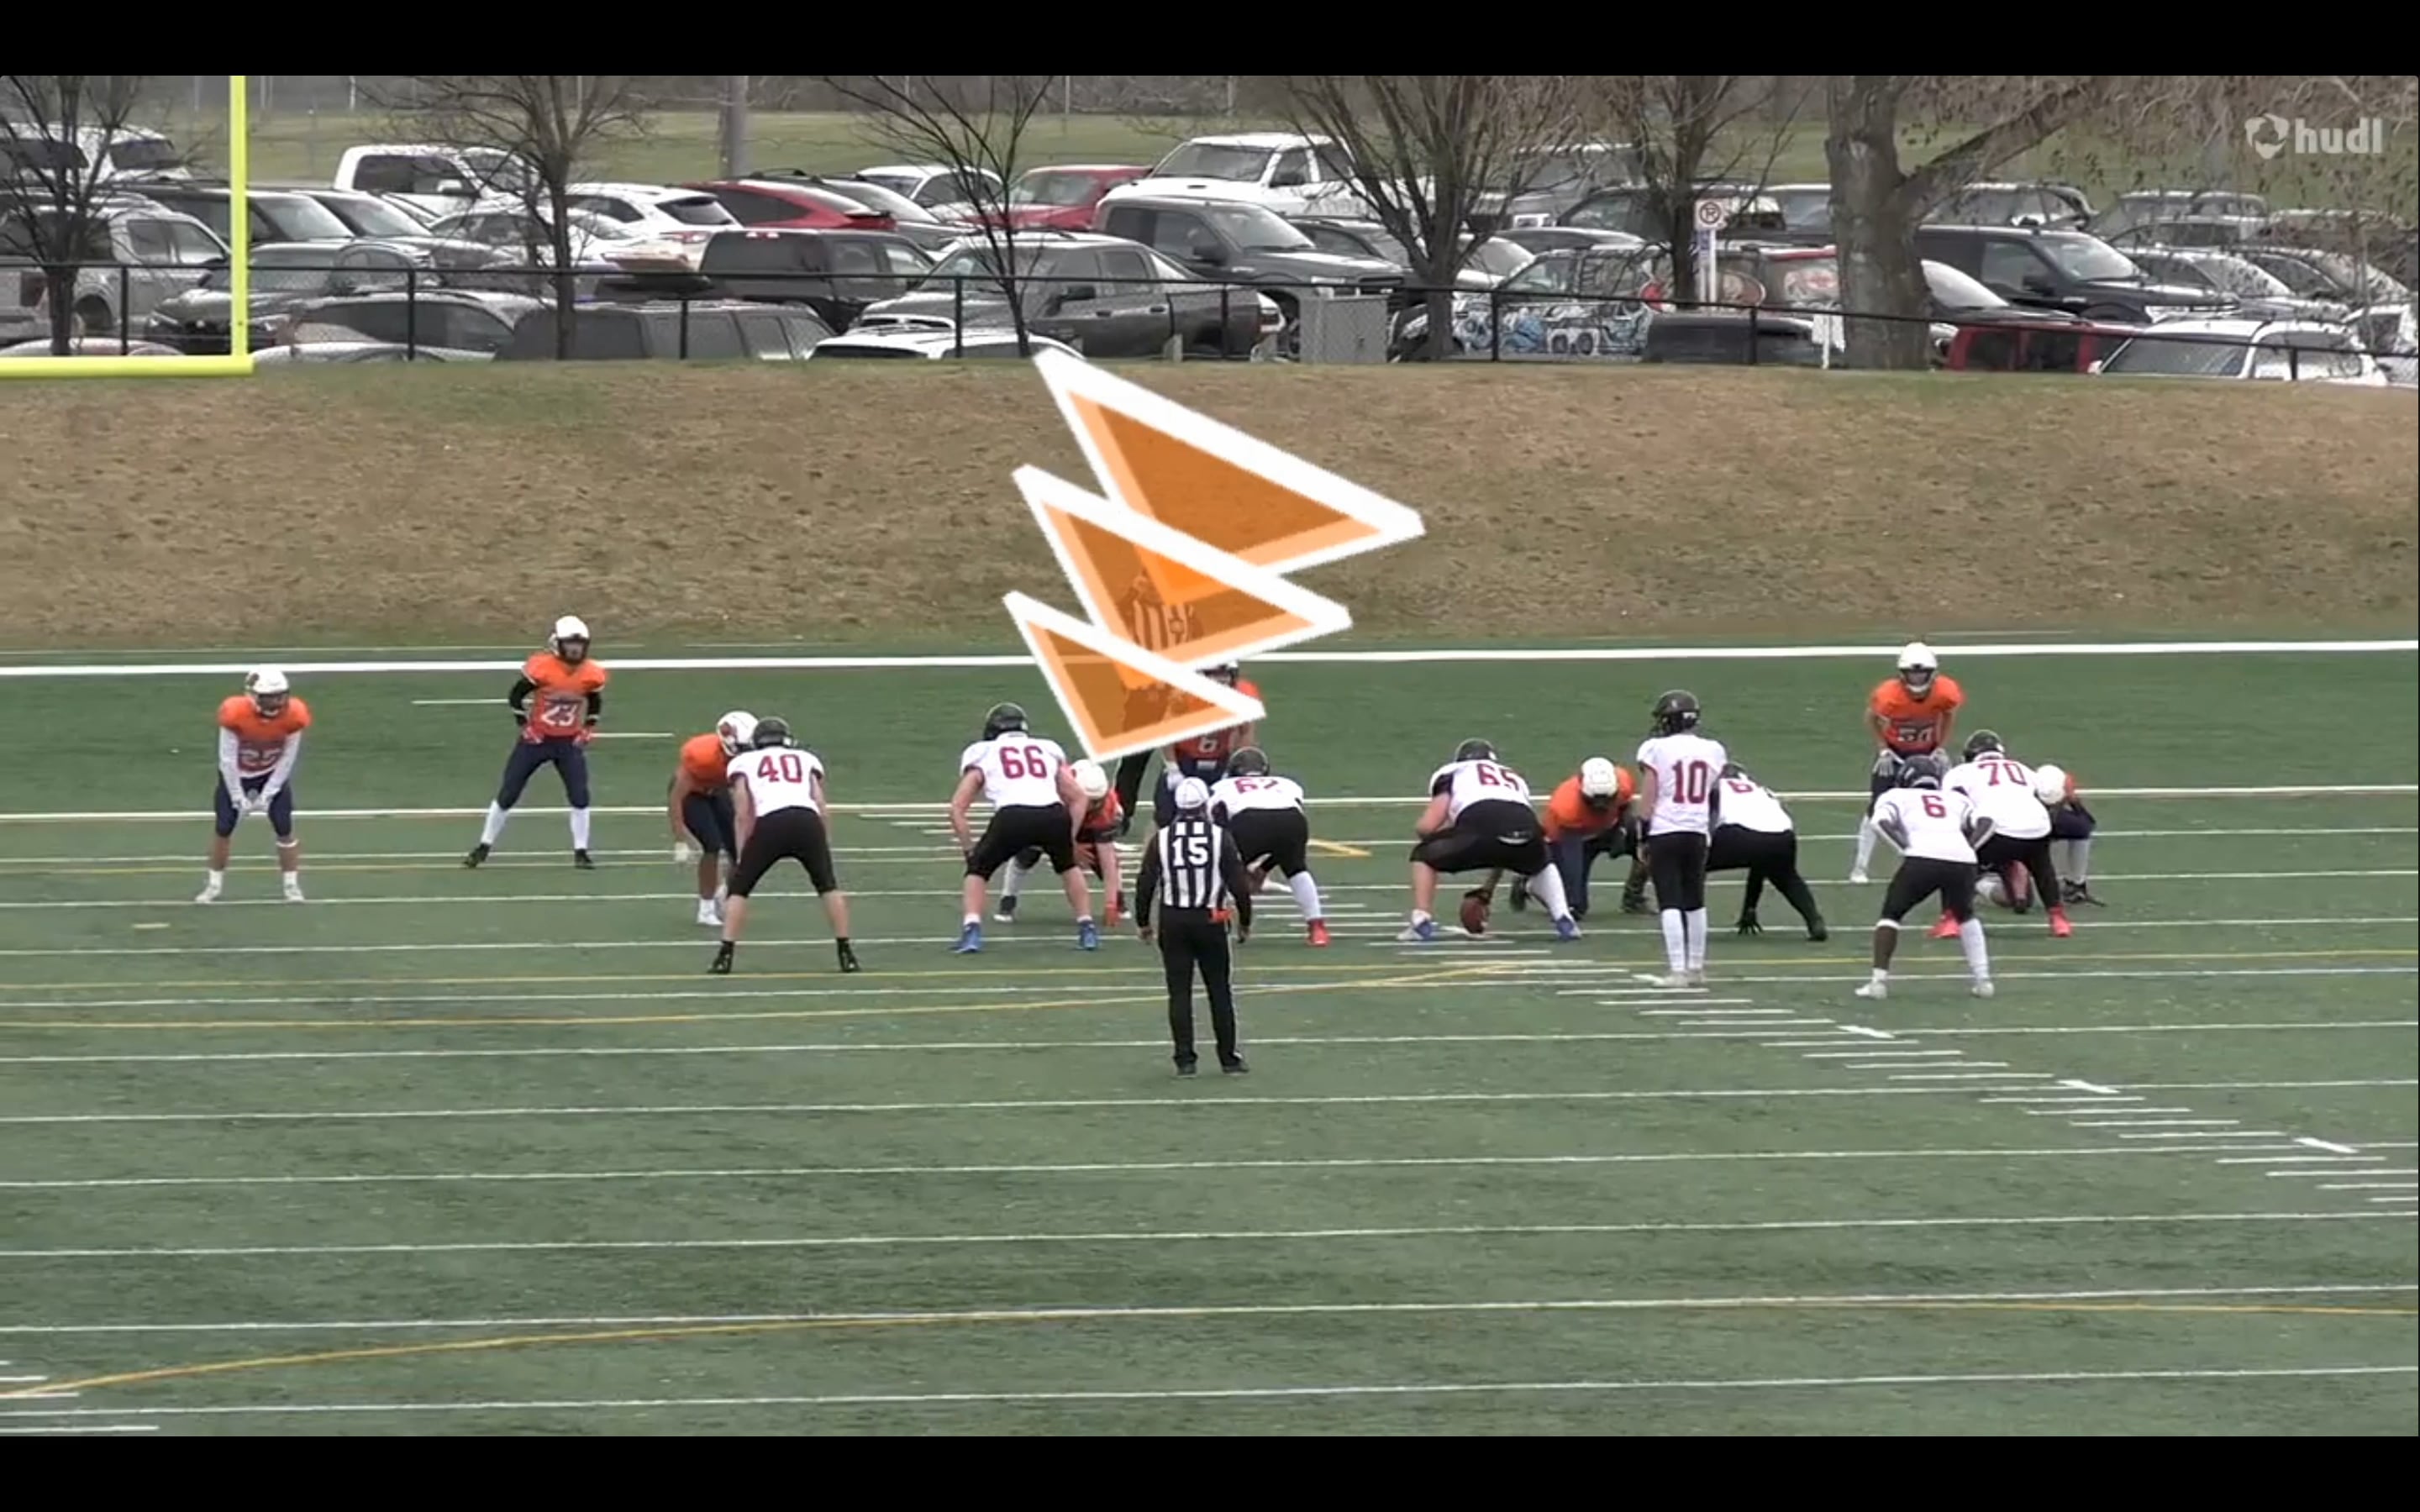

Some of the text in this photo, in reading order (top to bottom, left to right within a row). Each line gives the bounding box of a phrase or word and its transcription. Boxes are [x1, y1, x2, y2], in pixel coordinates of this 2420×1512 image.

[540, 701, 578, 727] 23
[757, 753, 802, 783] 40
[999, 745, 1048, 780] 66
[1978, 762, 2028, 786] 70
[1476, 763, 1520, 791] 65
[1672, 760, 1707, 804] 10
[1728, 780, 1756, 793] 6
[1921, 795, 1946, 818] 6
[1171, 836, 1209, 866] 15
